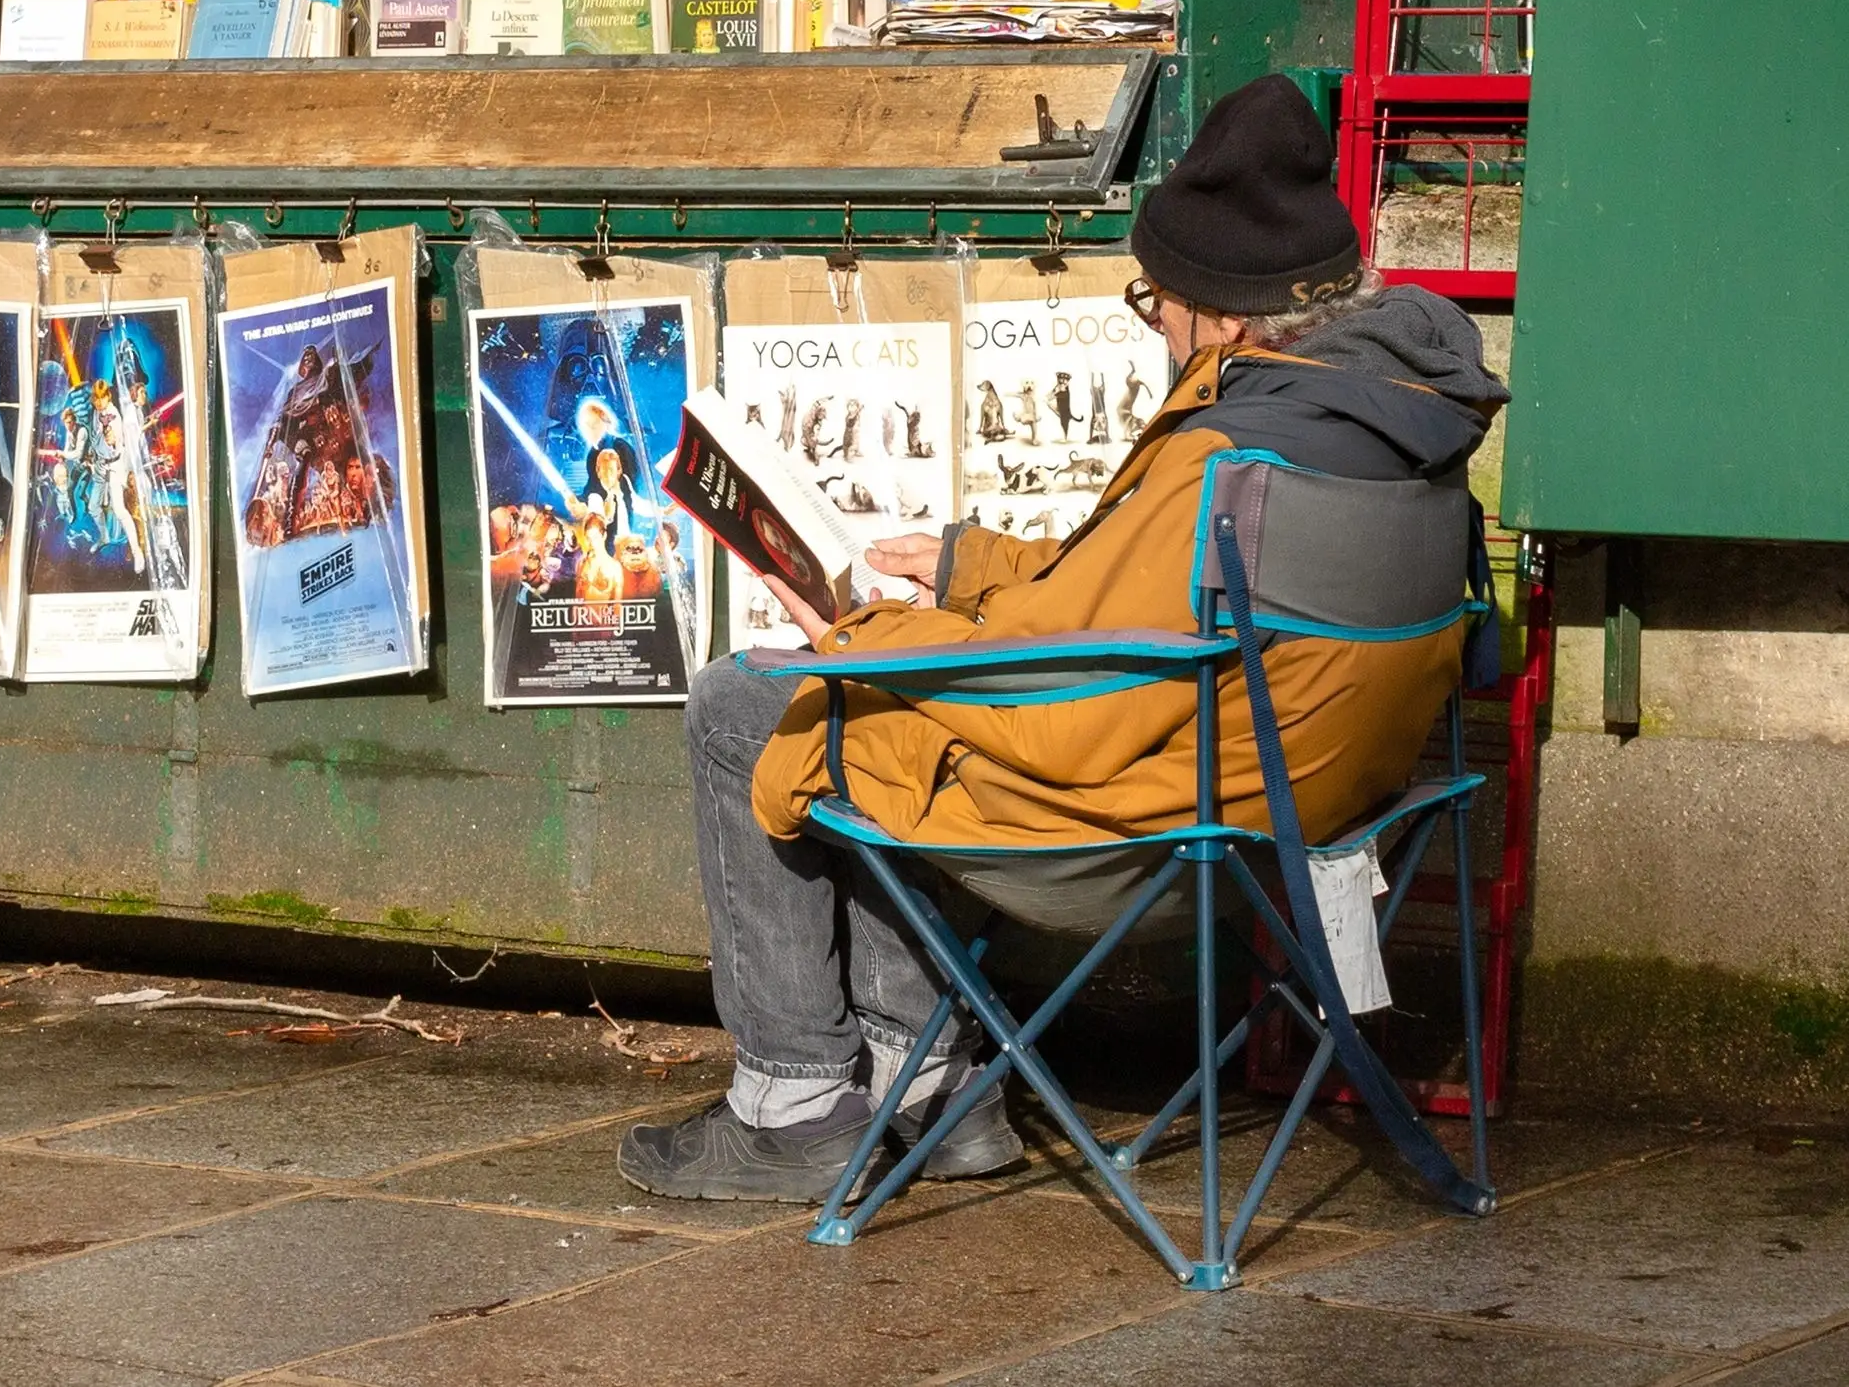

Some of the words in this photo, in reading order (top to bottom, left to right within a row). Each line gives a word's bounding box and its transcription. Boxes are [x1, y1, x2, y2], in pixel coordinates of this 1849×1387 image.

[388, 1, 412, 16] Paul
[415, 1, 450, 16] Auster
[490, 10, 502, 22] La
[503, 10, 540, 22] Descente
[686, 0, 759, 16] CASTELOT
[575, 13, 636, 27] amoureux
[716, 20, 757, 35] LOUIS
[725, 34, 757, 47] XVII
[243, 329, 261, 341] THE
[261, 323, 285, 339] STAR
[284, 320, 310, 336] WARS
[310, 314, 332, 329] SAGA
[332, 304, 373, 324] CONTINUES
[752, 340, 842, 370] YOGA
[852, 338, 920, 368] CATS
[710, 492, 721, 510] de
[300, 547, 355, 590] EMPIRE
[301, 576, 333, 600] STRIKES
[333, 566, 356, 583] BACK
[530, 605, 602, 628] RETURN
[603, 605, 615, 616] OF
[602, 615, 620, 625] THE
[613, 603, 657, 637] JEDI
